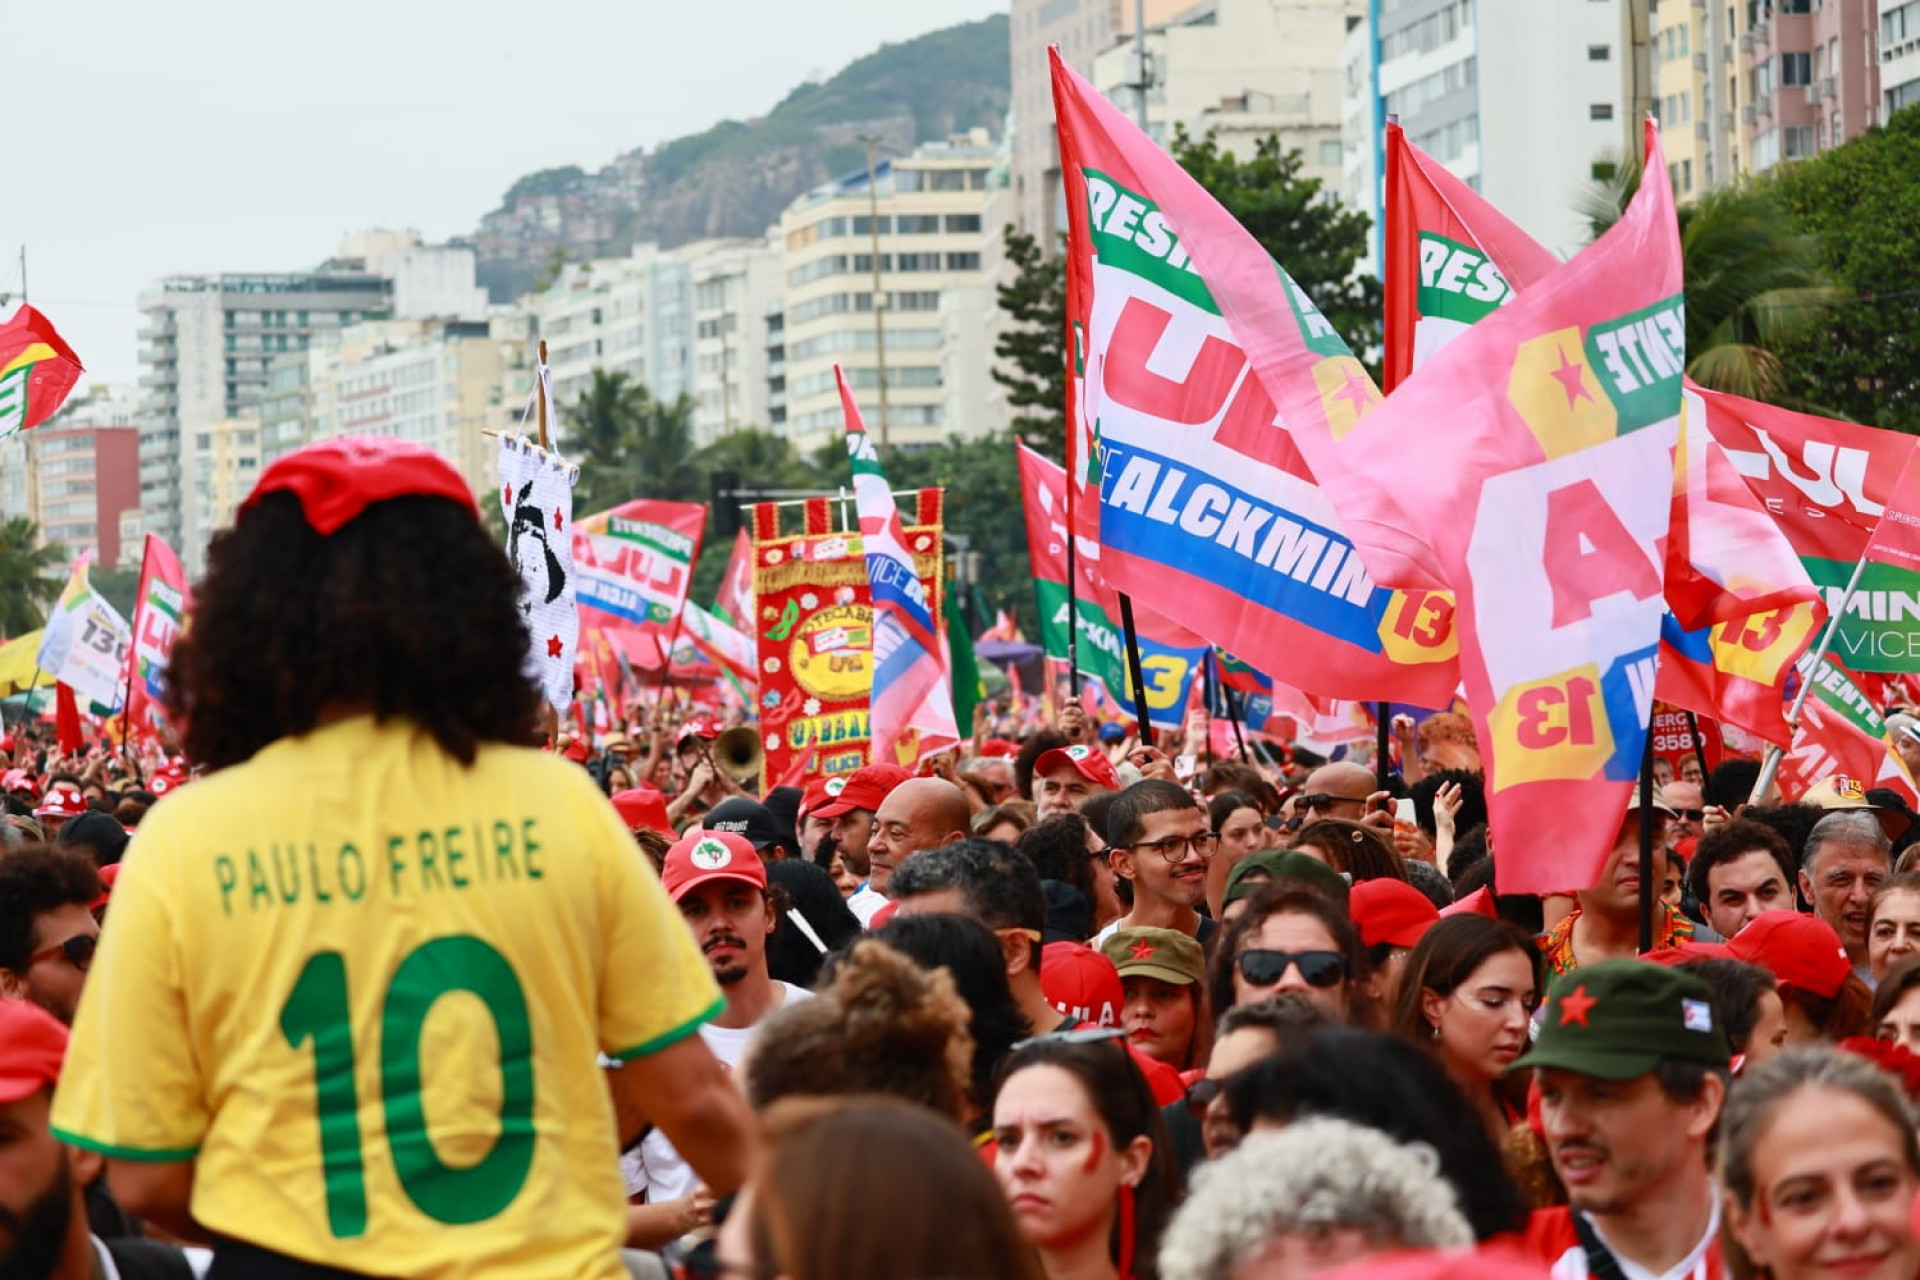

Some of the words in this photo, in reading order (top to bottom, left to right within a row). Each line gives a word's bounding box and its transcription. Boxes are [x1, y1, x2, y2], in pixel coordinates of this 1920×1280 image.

[1107, 455, 1376, 609] ALCKMIN
[1394, 588, 1456, 647] 13
[214, 839, 366, 916] PAULO
[386, 818, 545, 898] FREIRE
[279, 934, 536, 1239] 10
